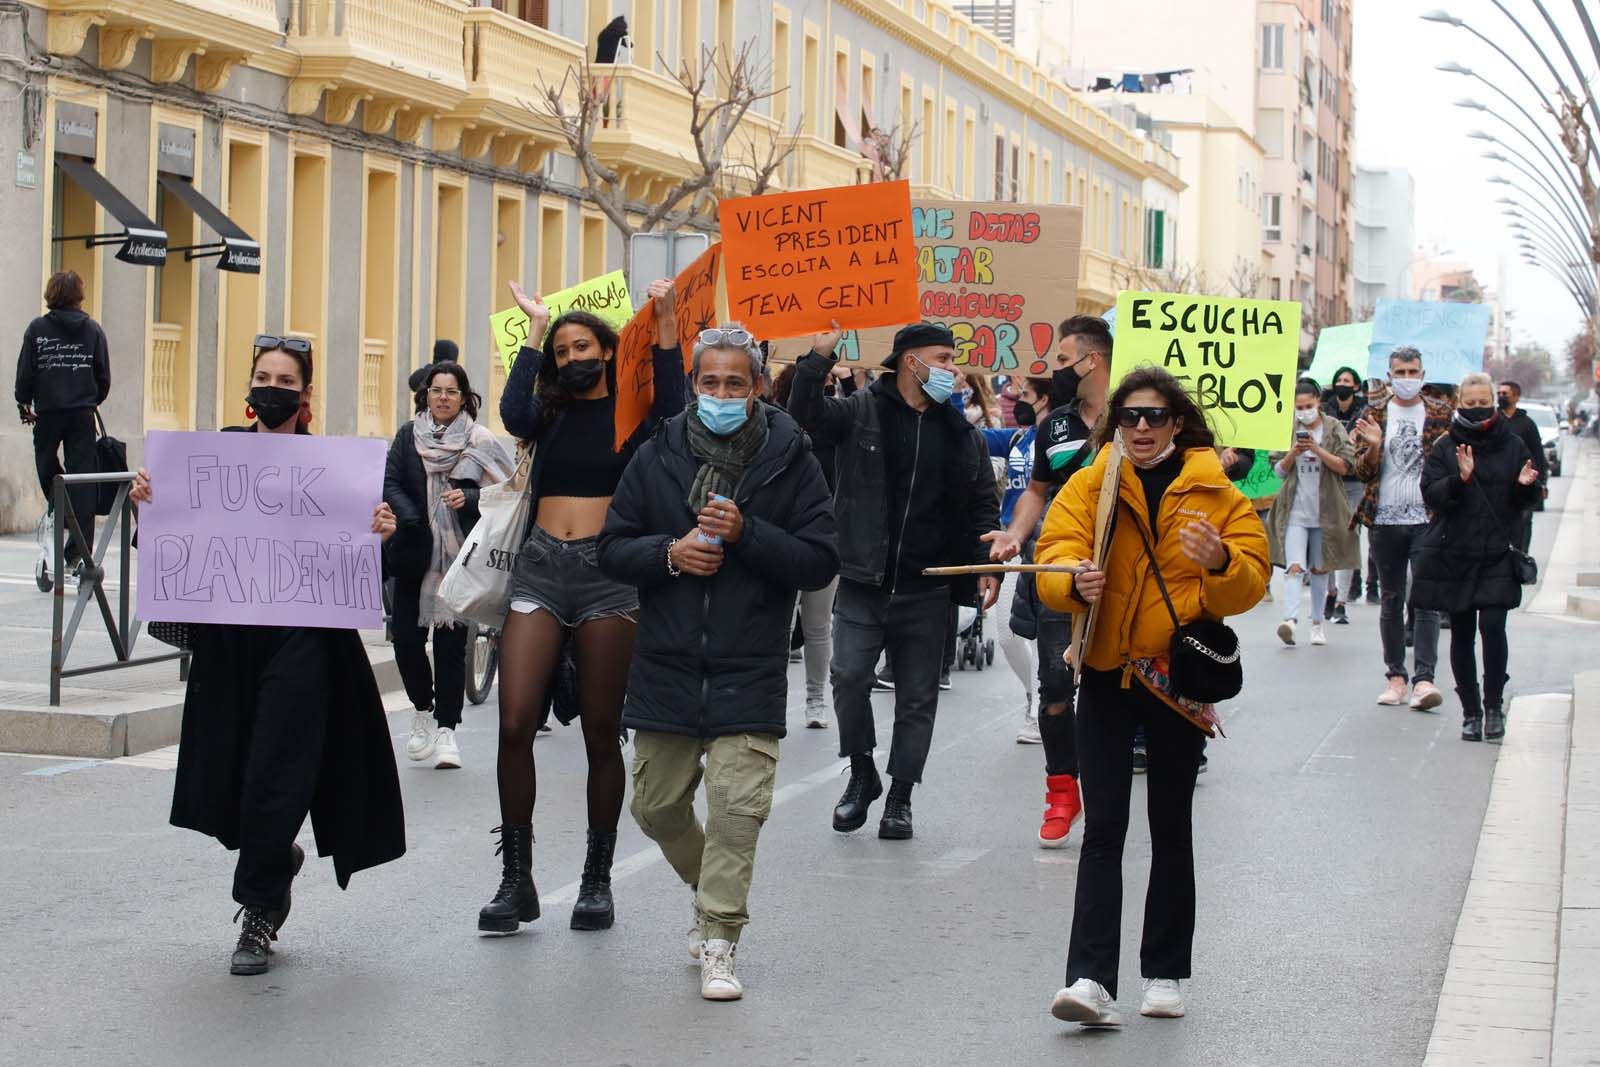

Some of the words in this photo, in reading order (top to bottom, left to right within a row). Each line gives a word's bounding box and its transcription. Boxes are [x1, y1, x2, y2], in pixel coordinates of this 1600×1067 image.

[737, 201, 828, 232] VICENT
[912, 208, 954, 240] ME
[968, 211, 1041, 243] DEJAS
[774, 220, 903, 252] PRESIDENT
[742, 256, 831, 281] ESCOLTA
[849, 250, 862, 266] A
[875, 248, 899, 265] LA
[916, 245, 994, 284] AJAR
[568, 281, 627, 313] TRABAJO
[738, 292, 802, 317] TEVA
[818, 280, 895, 310] GENT
[1132, 299, 1283, 336] ESCUCHA
[932, 321, 1054, 375] GAR!
[1163, 338, 1187, 367] A
[1198, 341, 1236, 369] TU
[1173, 372, 1284, 413] BLO!
[187, 455, 327, 516] FUCK
[154, 531, 383, 611] PLANDEMIA
